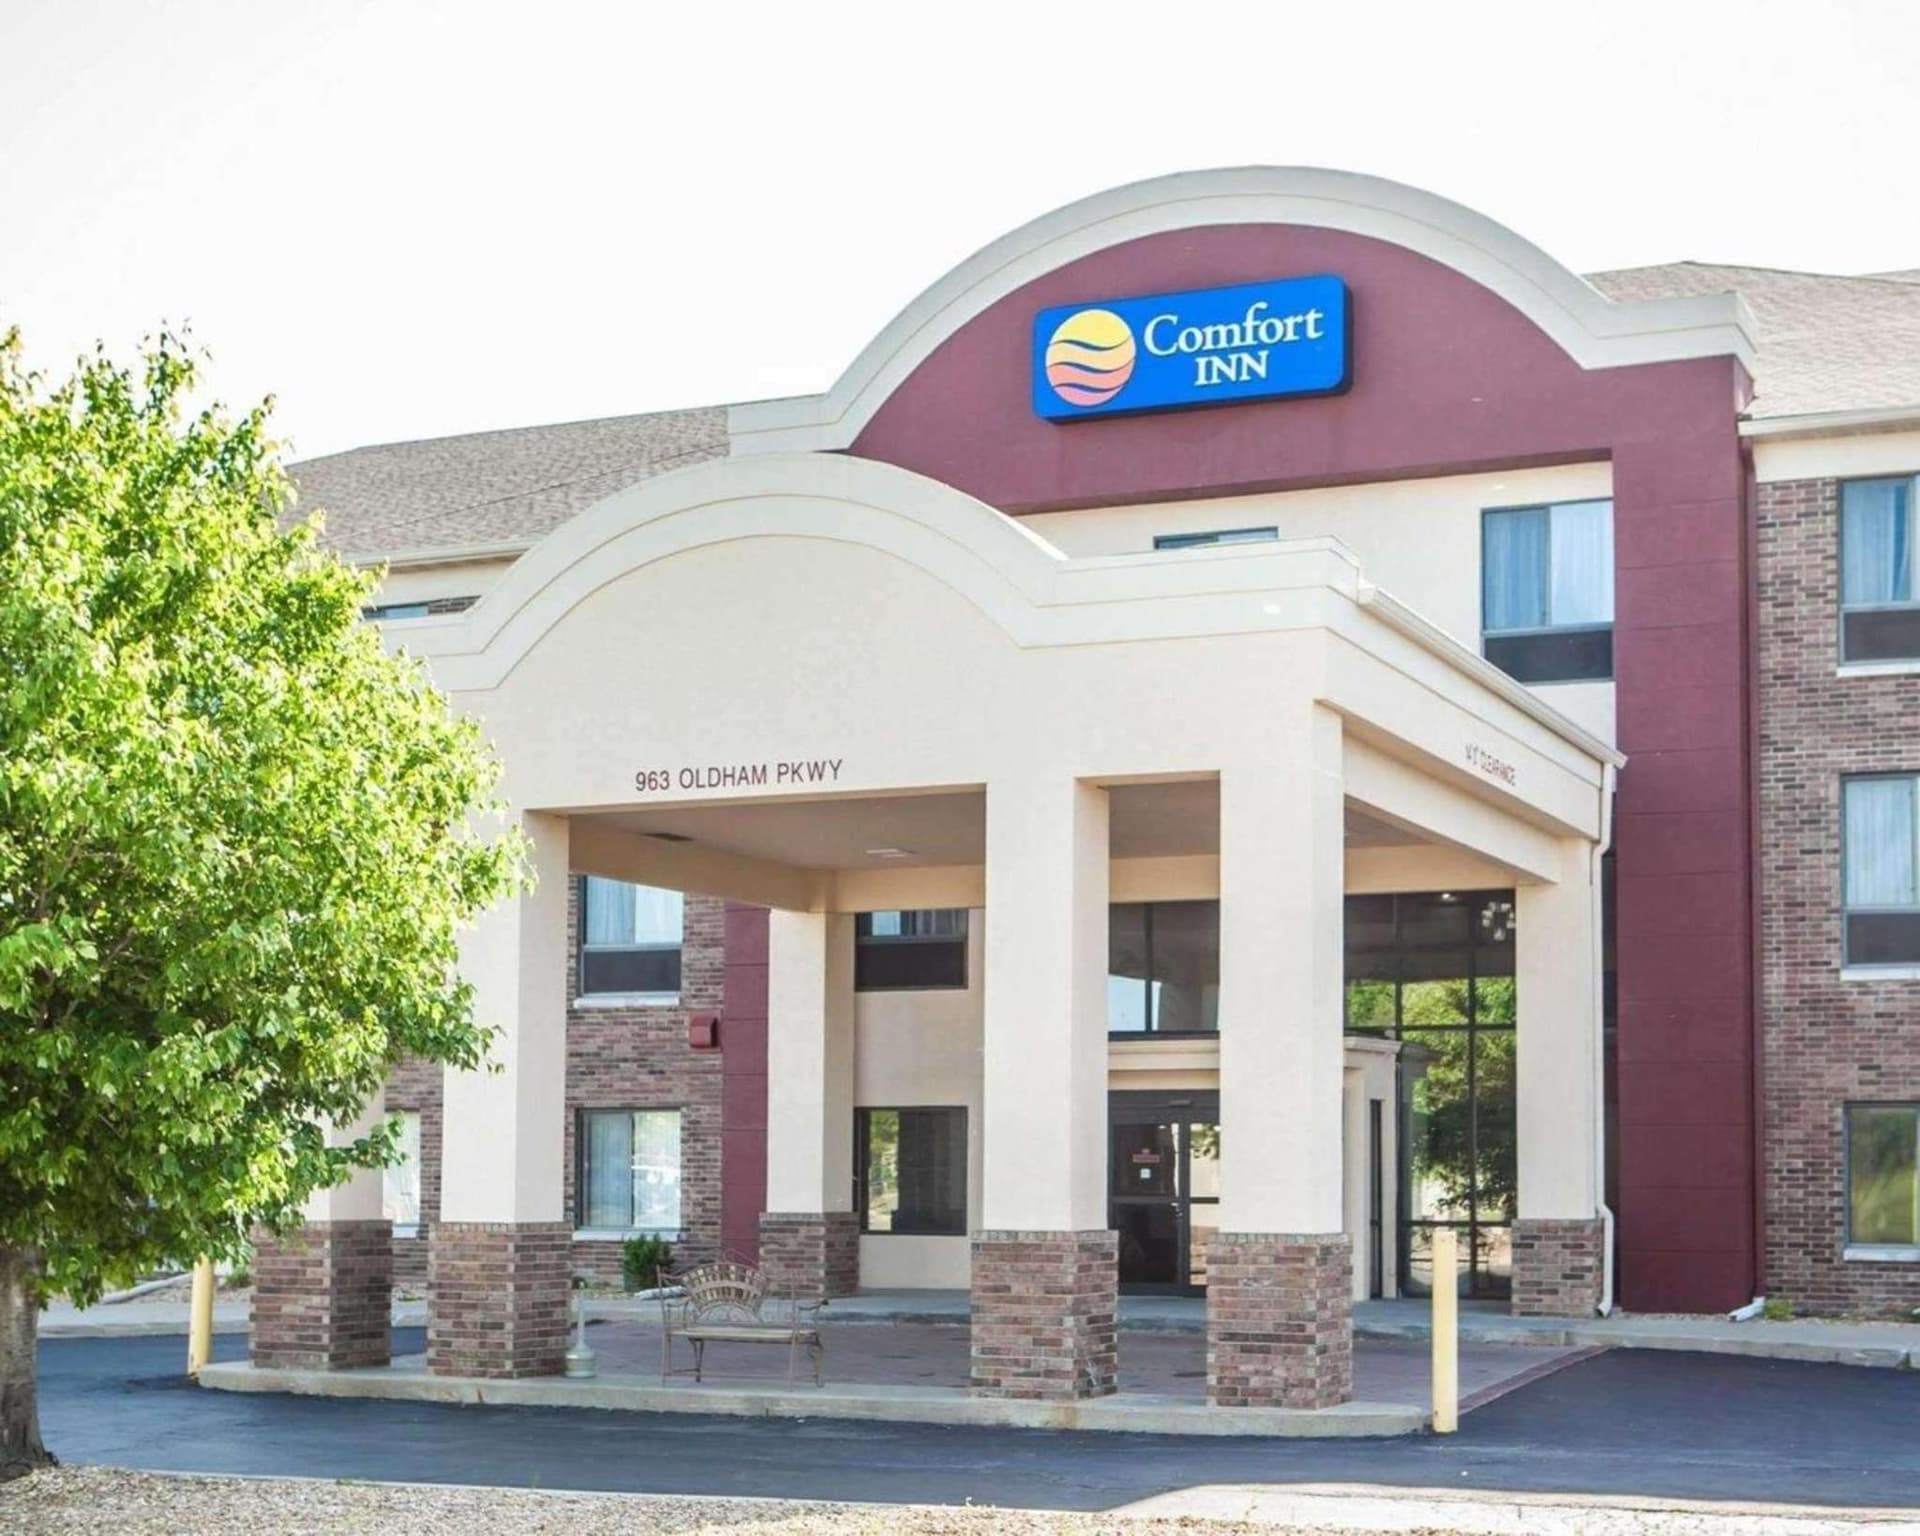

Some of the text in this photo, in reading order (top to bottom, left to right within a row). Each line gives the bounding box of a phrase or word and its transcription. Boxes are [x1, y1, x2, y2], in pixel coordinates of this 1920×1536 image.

[1143, 302, 1323, 356] Comfort
[1194, 350, 1269, 386] INN
[635, 759, 843, 791] 963 OLDHAM PKWY
